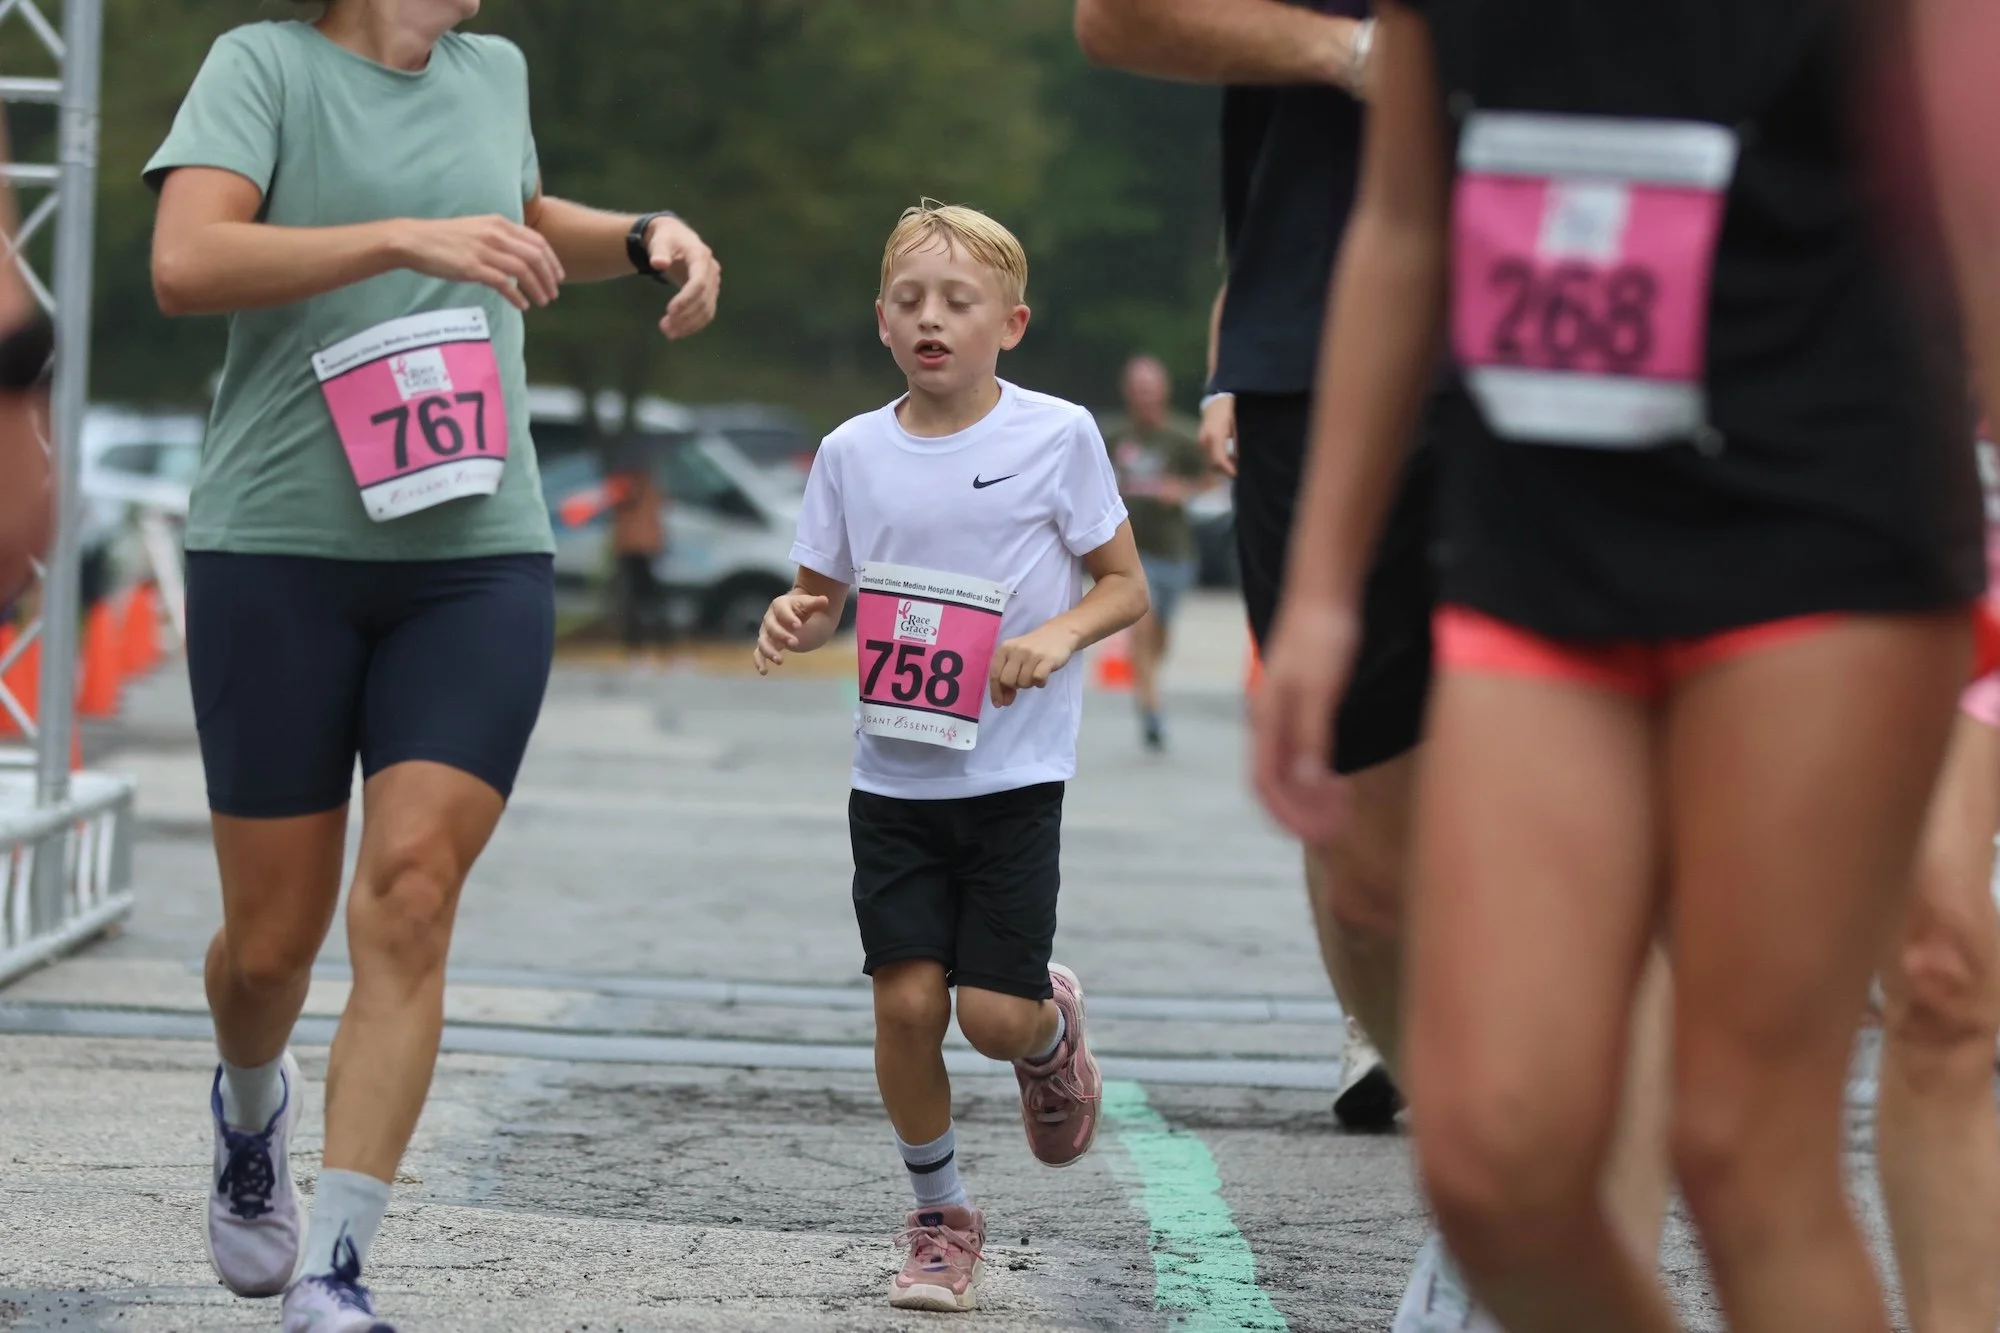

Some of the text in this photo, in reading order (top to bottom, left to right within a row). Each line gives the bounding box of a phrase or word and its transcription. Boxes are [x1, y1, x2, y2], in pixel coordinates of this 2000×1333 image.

[1486, 257, 1657, 374] 268
[370, 391, 487, 470] 767
[885, 578, 902, 588] Clinic
[903, 581, 927, 591] Medina
[927, 584, 955, 597] Hospital
[956, 589, 983, 601] Medical
[984, 595, 1001, 606] Staff
[900, 620, 929, 635] Grace
[908, 614, 931, 626] Race
[863, 639, 964, 708] 758
